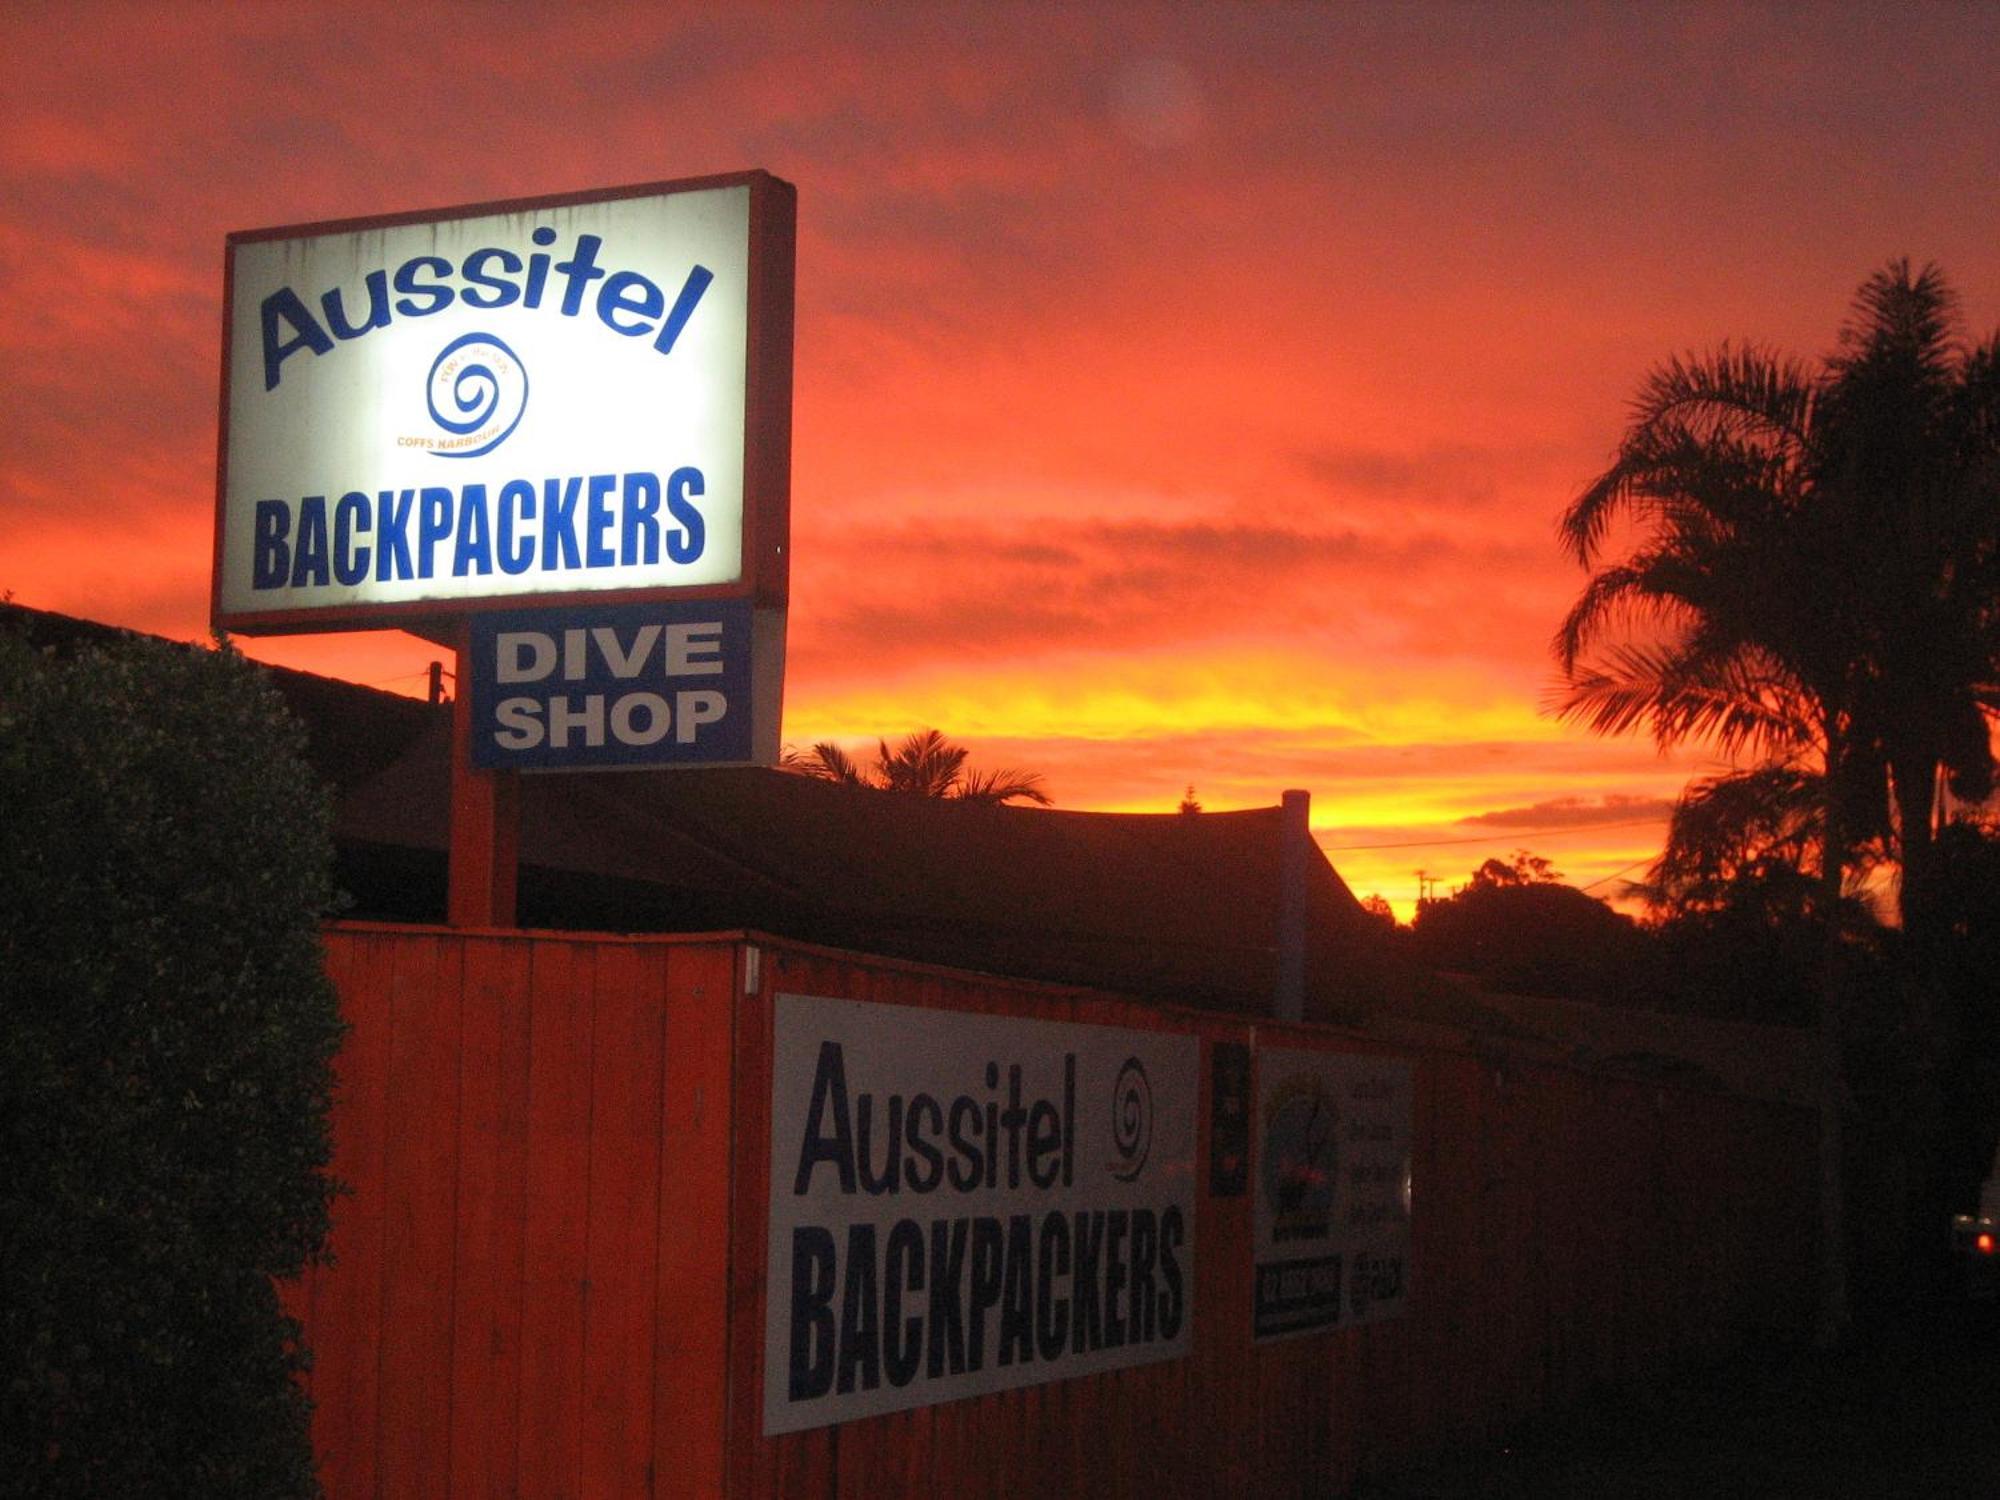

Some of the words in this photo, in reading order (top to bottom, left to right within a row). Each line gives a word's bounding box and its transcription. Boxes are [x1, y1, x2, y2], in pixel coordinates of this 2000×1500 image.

[260, 227, 714, 392] Aussitel
[397, 437, 434, 449] COFFS
[252, 467, 706, 590] BACKPACKERS
[495, 622, 724, 684] DIVE
[494, 690, 728, 749] SHOP
[794, 1040, 1076, 1196] Aussitel
[788, 1205, 1185, 1402] BACKPACKERS
